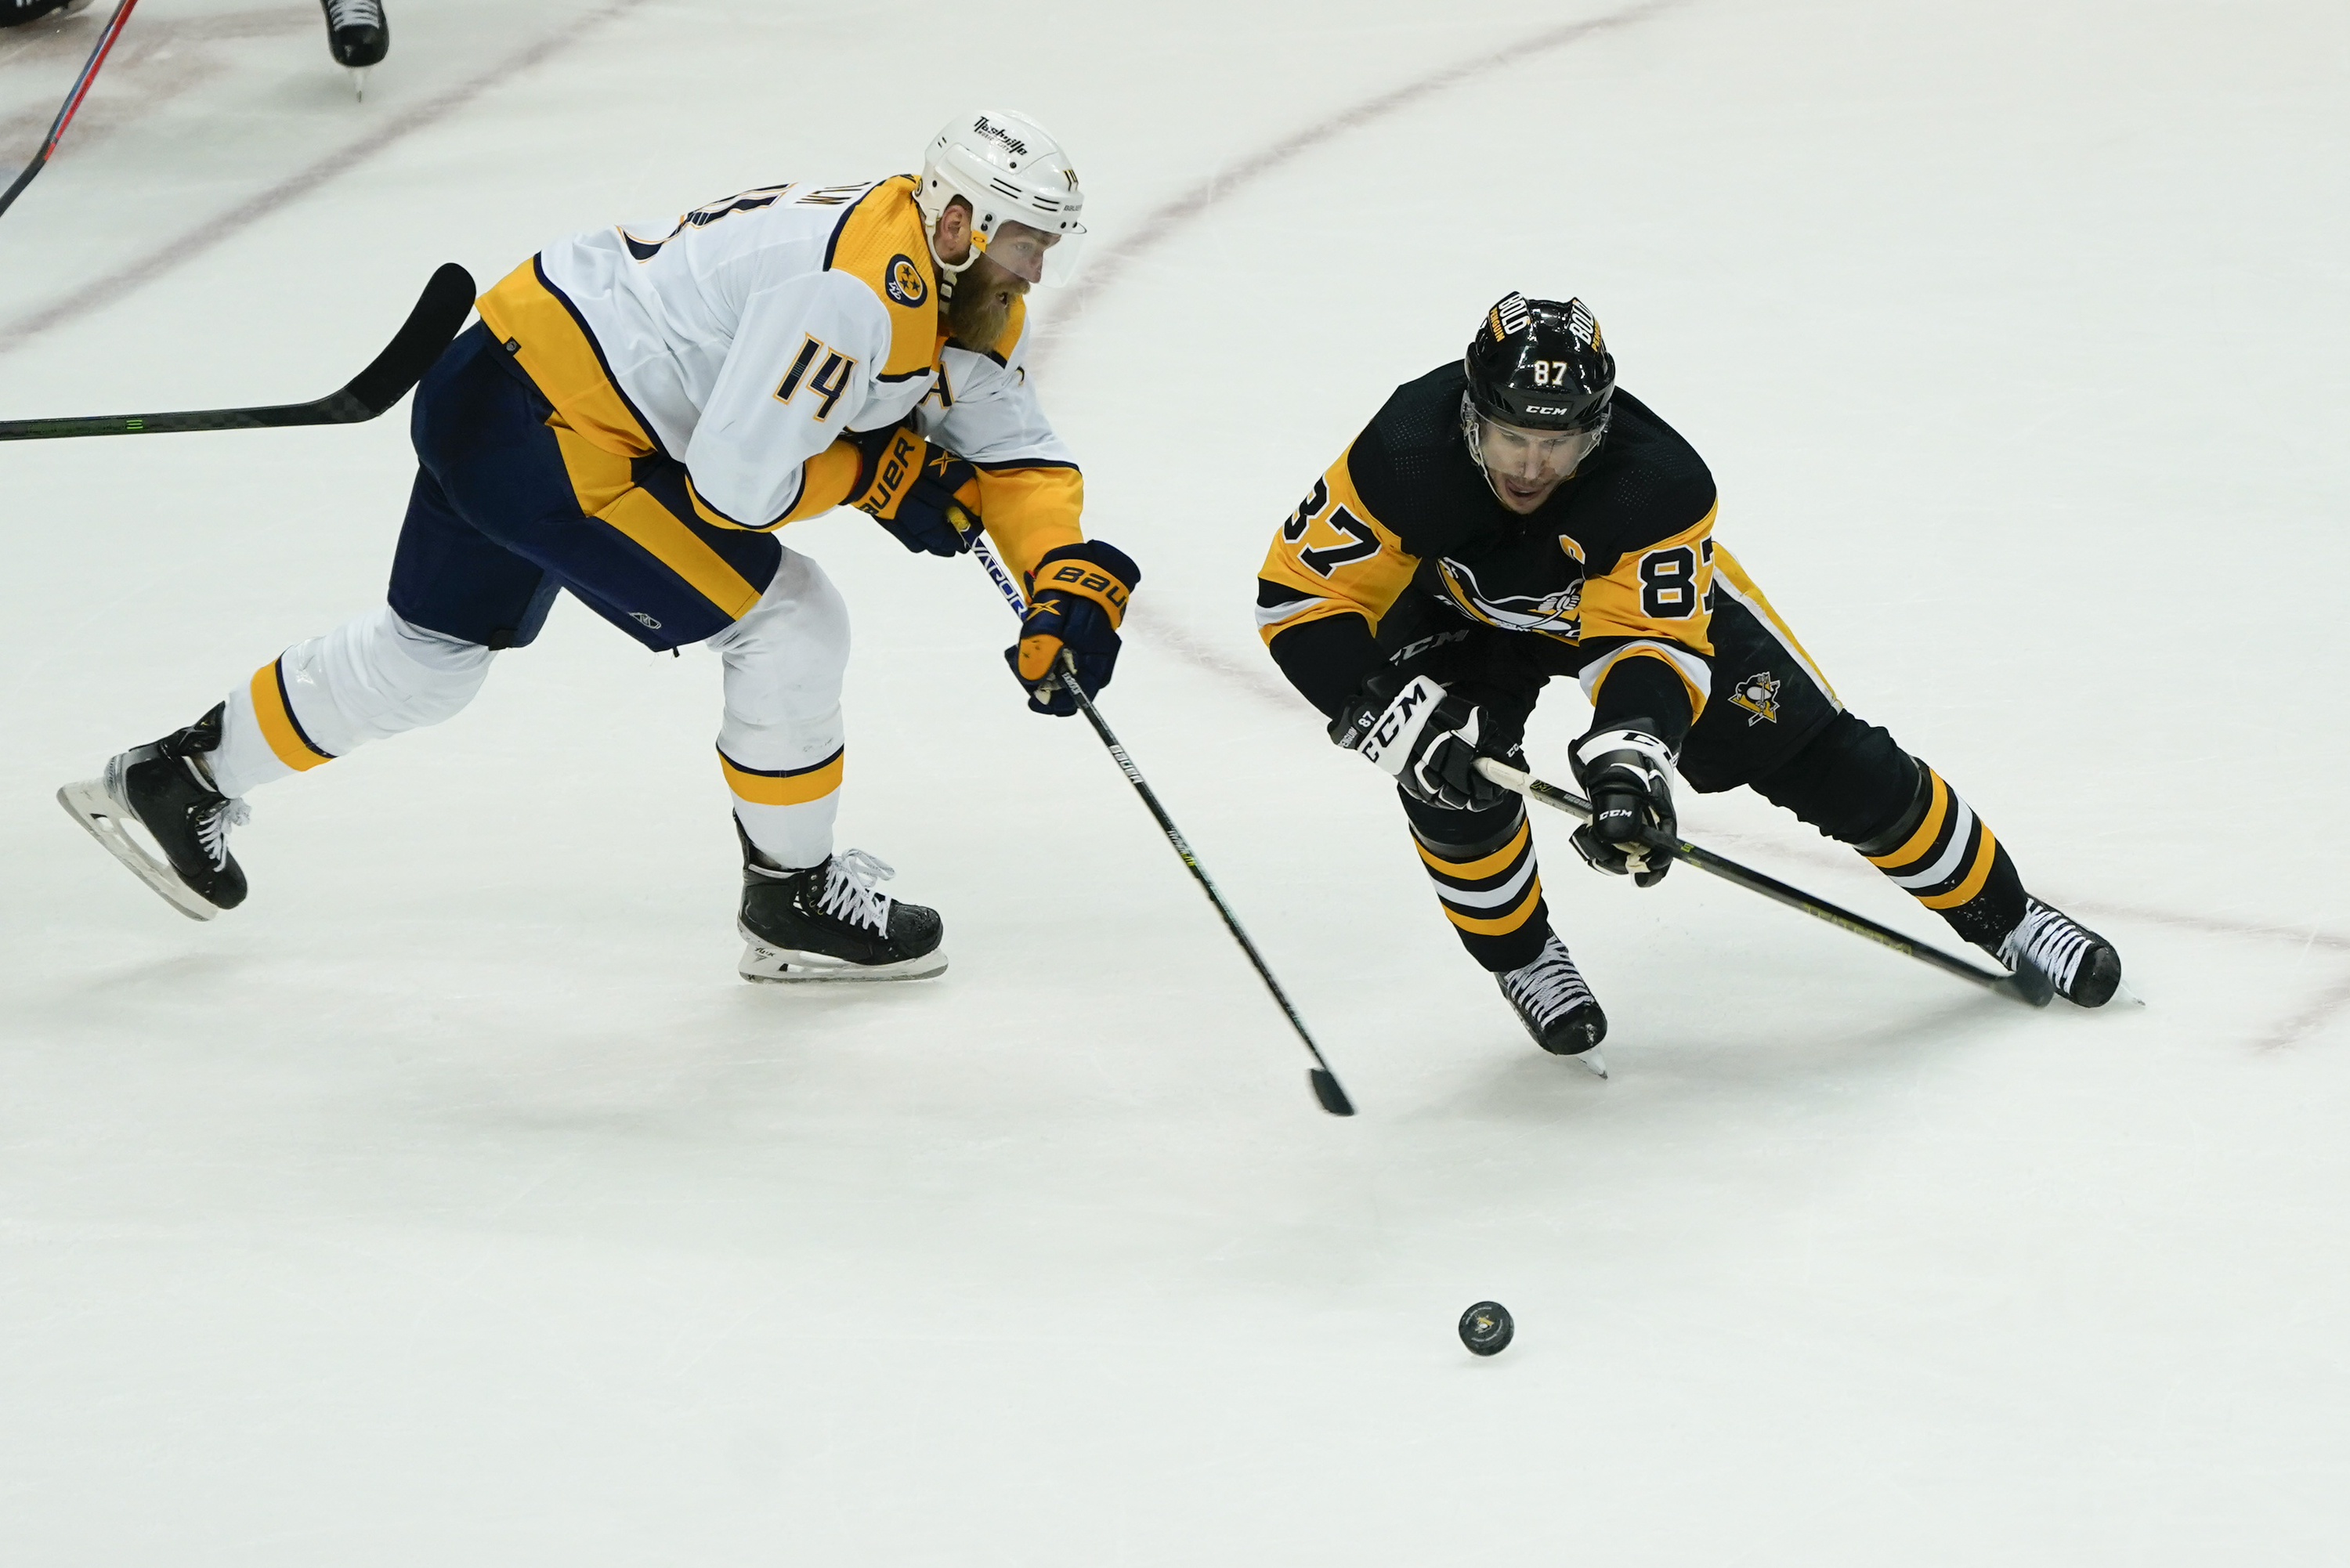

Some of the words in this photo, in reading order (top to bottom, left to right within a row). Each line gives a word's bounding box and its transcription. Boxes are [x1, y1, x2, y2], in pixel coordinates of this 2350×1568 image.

[1490, 306, 1506, 342] PENGUIN
[1499, 294, 1531, 335] BOLD
[1568, 299, 1594, 345] BOLD
[772, 332, 859, 422] 14
[1533, 360, 1567, 386] 87
[1525, 405, 1568, 416] CCM
[859, 436, 915, 515] AUER
[971, 537, 1029, 620] VAPOR
[1052, 565, 1127, 616] BAU
[1358, 710, 1376, 728] 87
[1361, 682, 1426, 763] CCM
[1599, 809, 1632, 821] CCM
